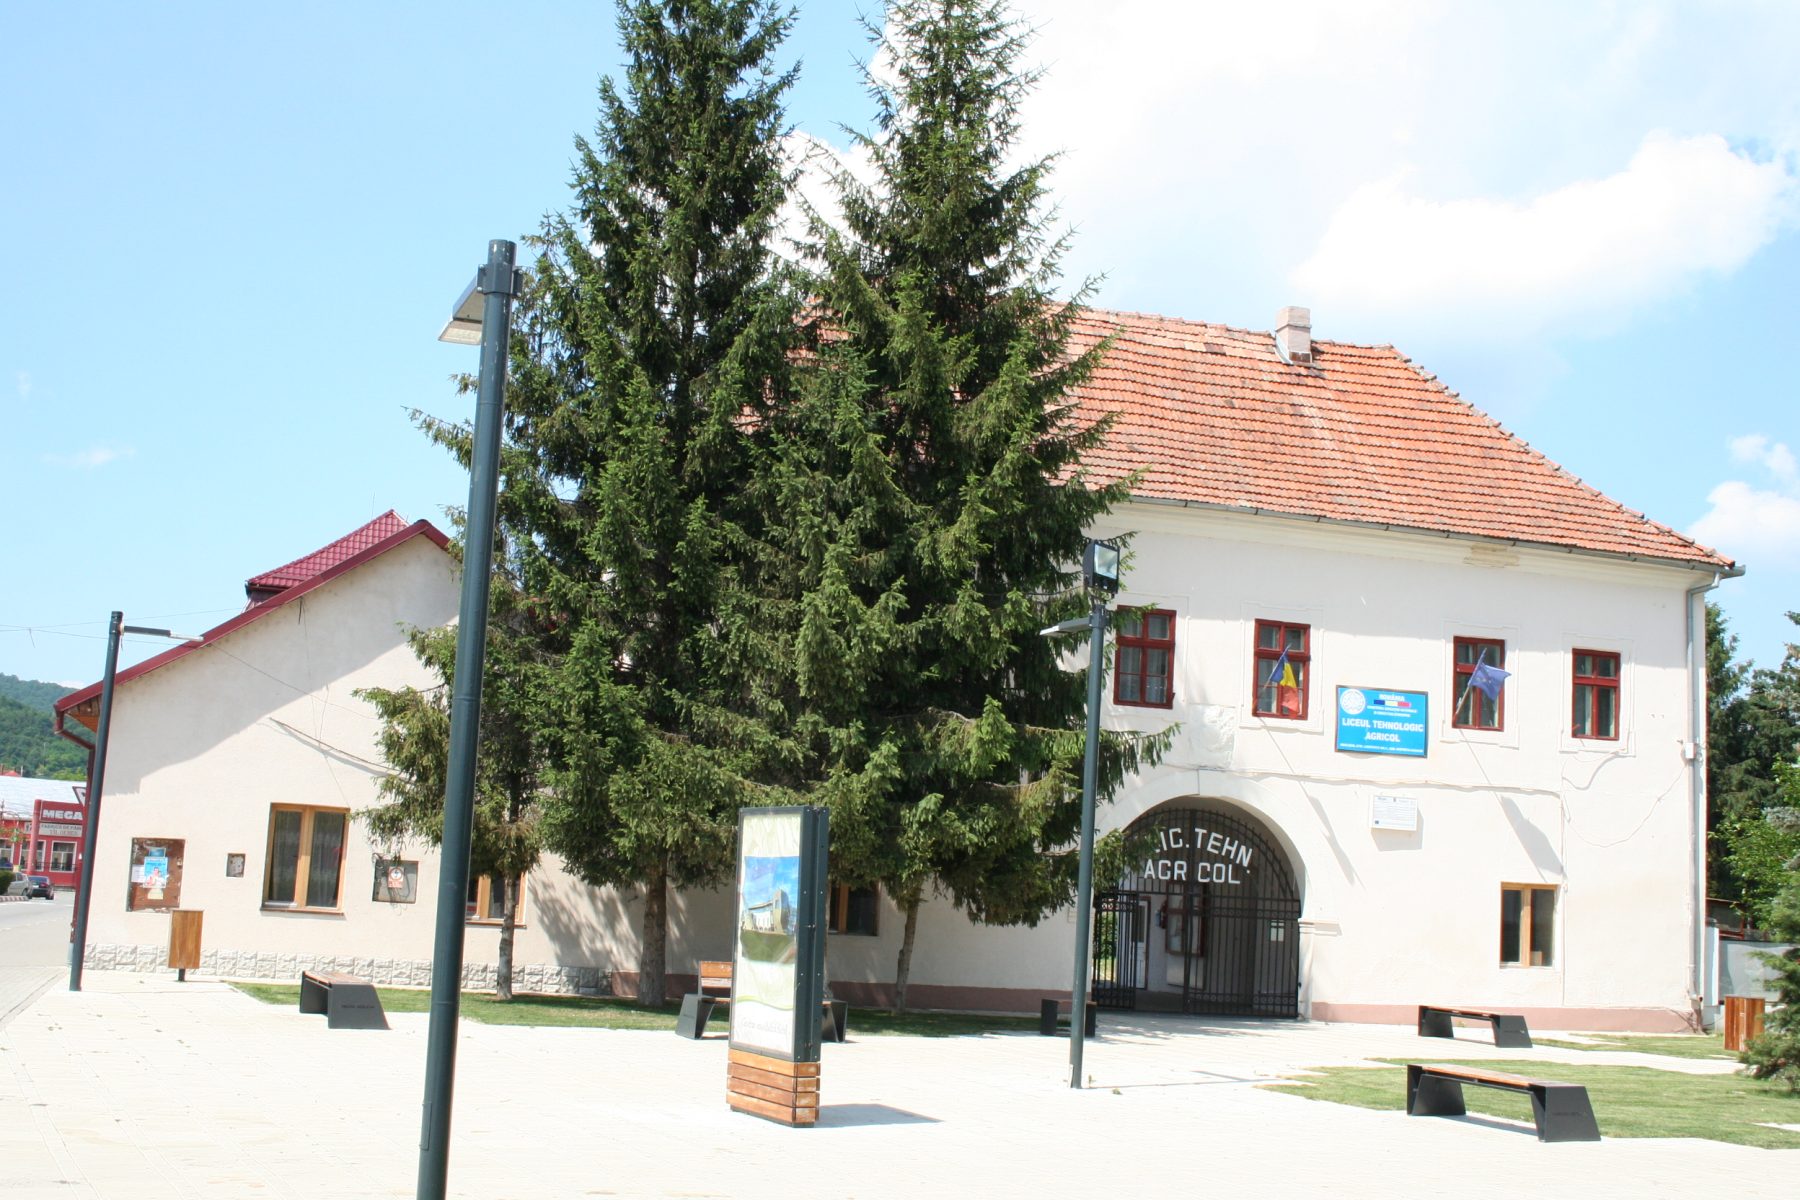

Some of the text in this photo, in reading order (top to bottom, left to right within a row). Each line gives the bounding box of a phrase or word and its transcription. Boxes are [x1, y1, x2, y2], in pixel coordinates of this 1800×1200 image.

[1342, 717, 1424, 732] LICEUL TEHNOLOGIC
[1364, 731, 1400, 742] AGRICOL
[42, 809, 83, 820] MEGA
[1143, 858, 1241, 884] AGR COL
